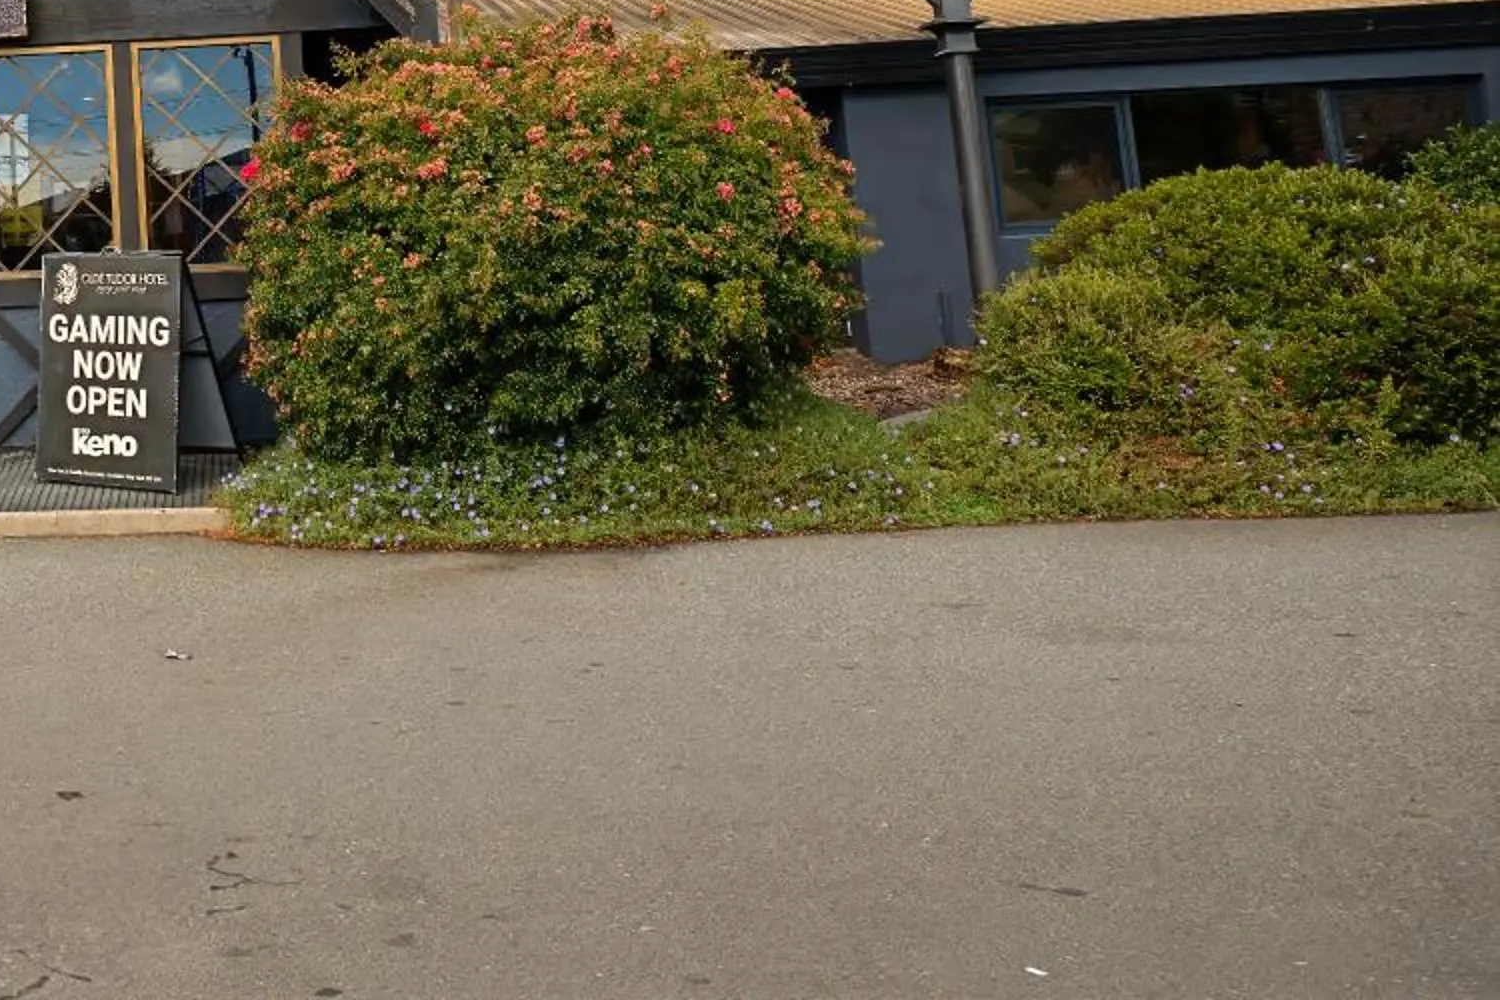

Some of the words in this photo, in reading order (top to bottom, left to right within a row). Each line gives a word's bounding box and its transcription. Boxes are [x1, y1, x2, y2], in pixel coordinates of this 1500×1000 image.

[49, 313, 171, 347] GAMING
[73, 350, 143, 381] NOW
[66, 385, 148, 419] OPEN
